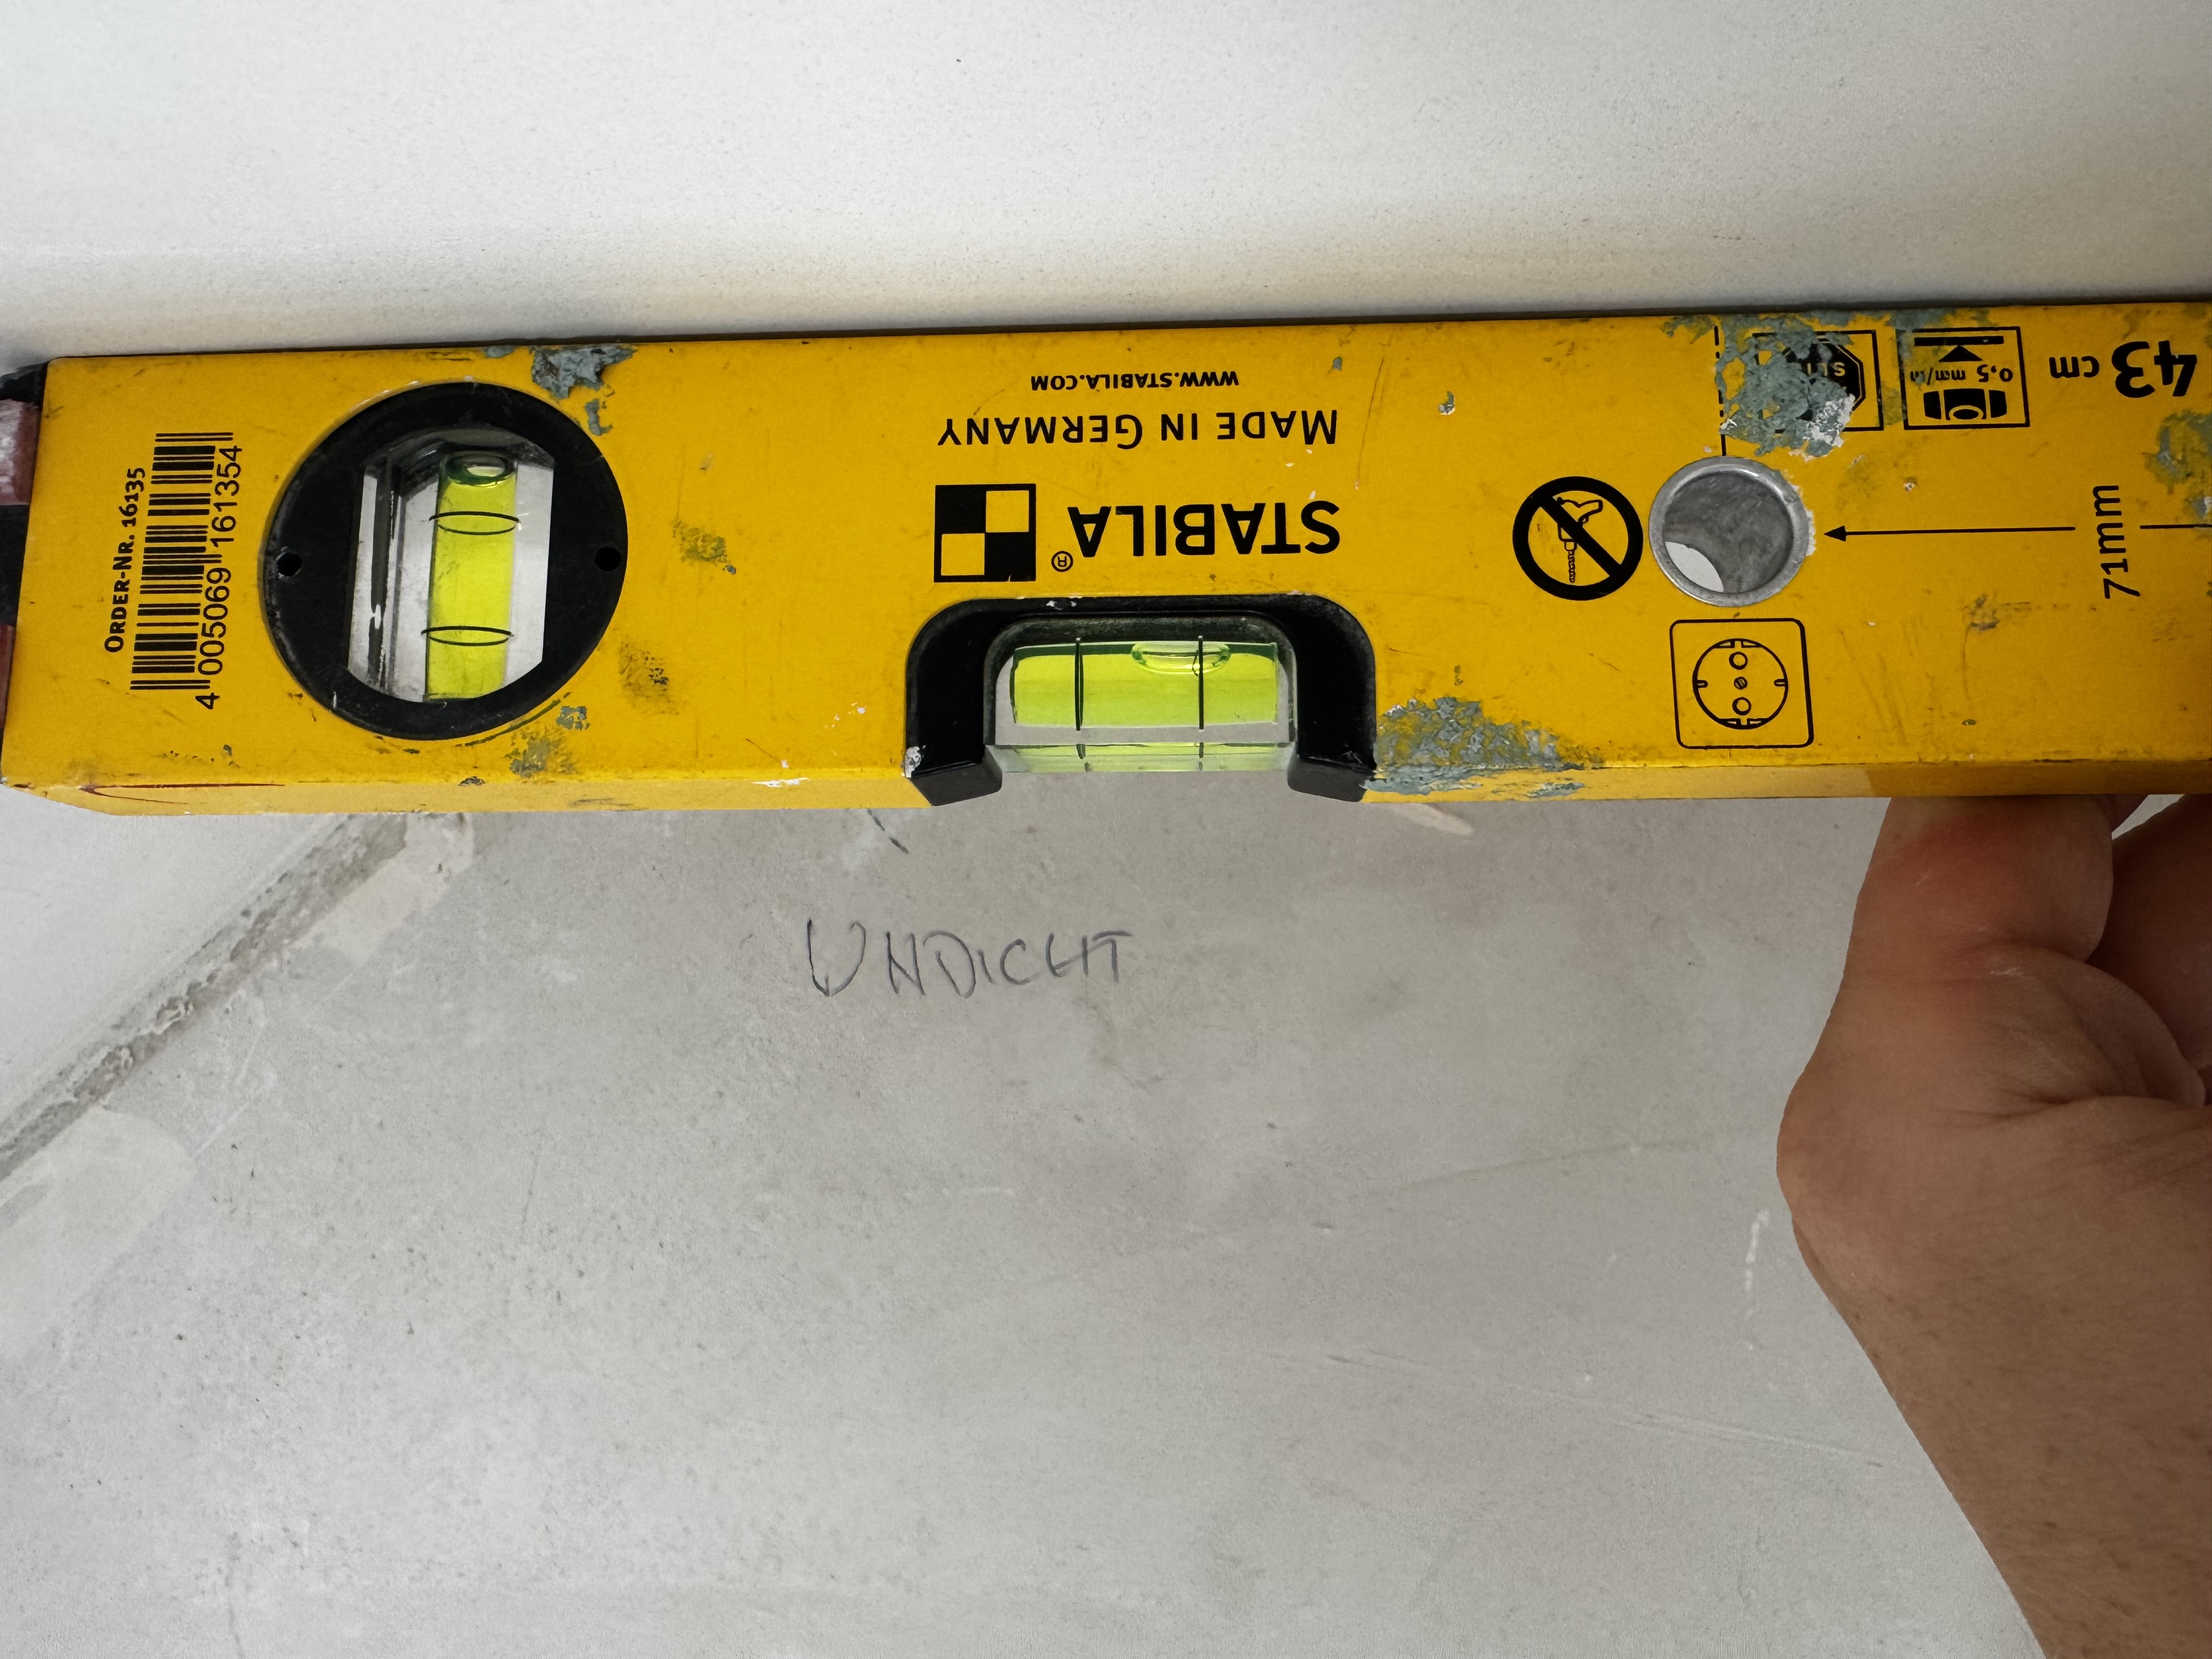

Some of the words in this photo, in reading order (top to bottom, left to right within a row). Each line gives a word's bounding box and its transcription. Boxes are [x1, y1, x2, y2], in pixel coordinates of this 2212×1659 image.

[1031, 371, 1239, 391] WWW.STABILA.COM
[1806, 362, 1847, 377] SLI
[1977, 364, 2013, 383] 0,5
[2049, 356, 2100, 379] cm
[2111, 340, 2198, 398] 43
[938, 414, 1143, 450] GERMANY
[1161, 413, 1198, 441] IN
[1216, 410, 1337, 445] MADE
[119, 467, 145, 528] 16135
[210, 445, 242, 548] 161354
[2092, 485, 2141, 600] 71mm
[104, 535, 135, 653] ORDER-NR.
[198, 565, 232, 675] 005069
[195, 692, 220, 710] 4
[807, 918, 1132, 998] UNDICHT
